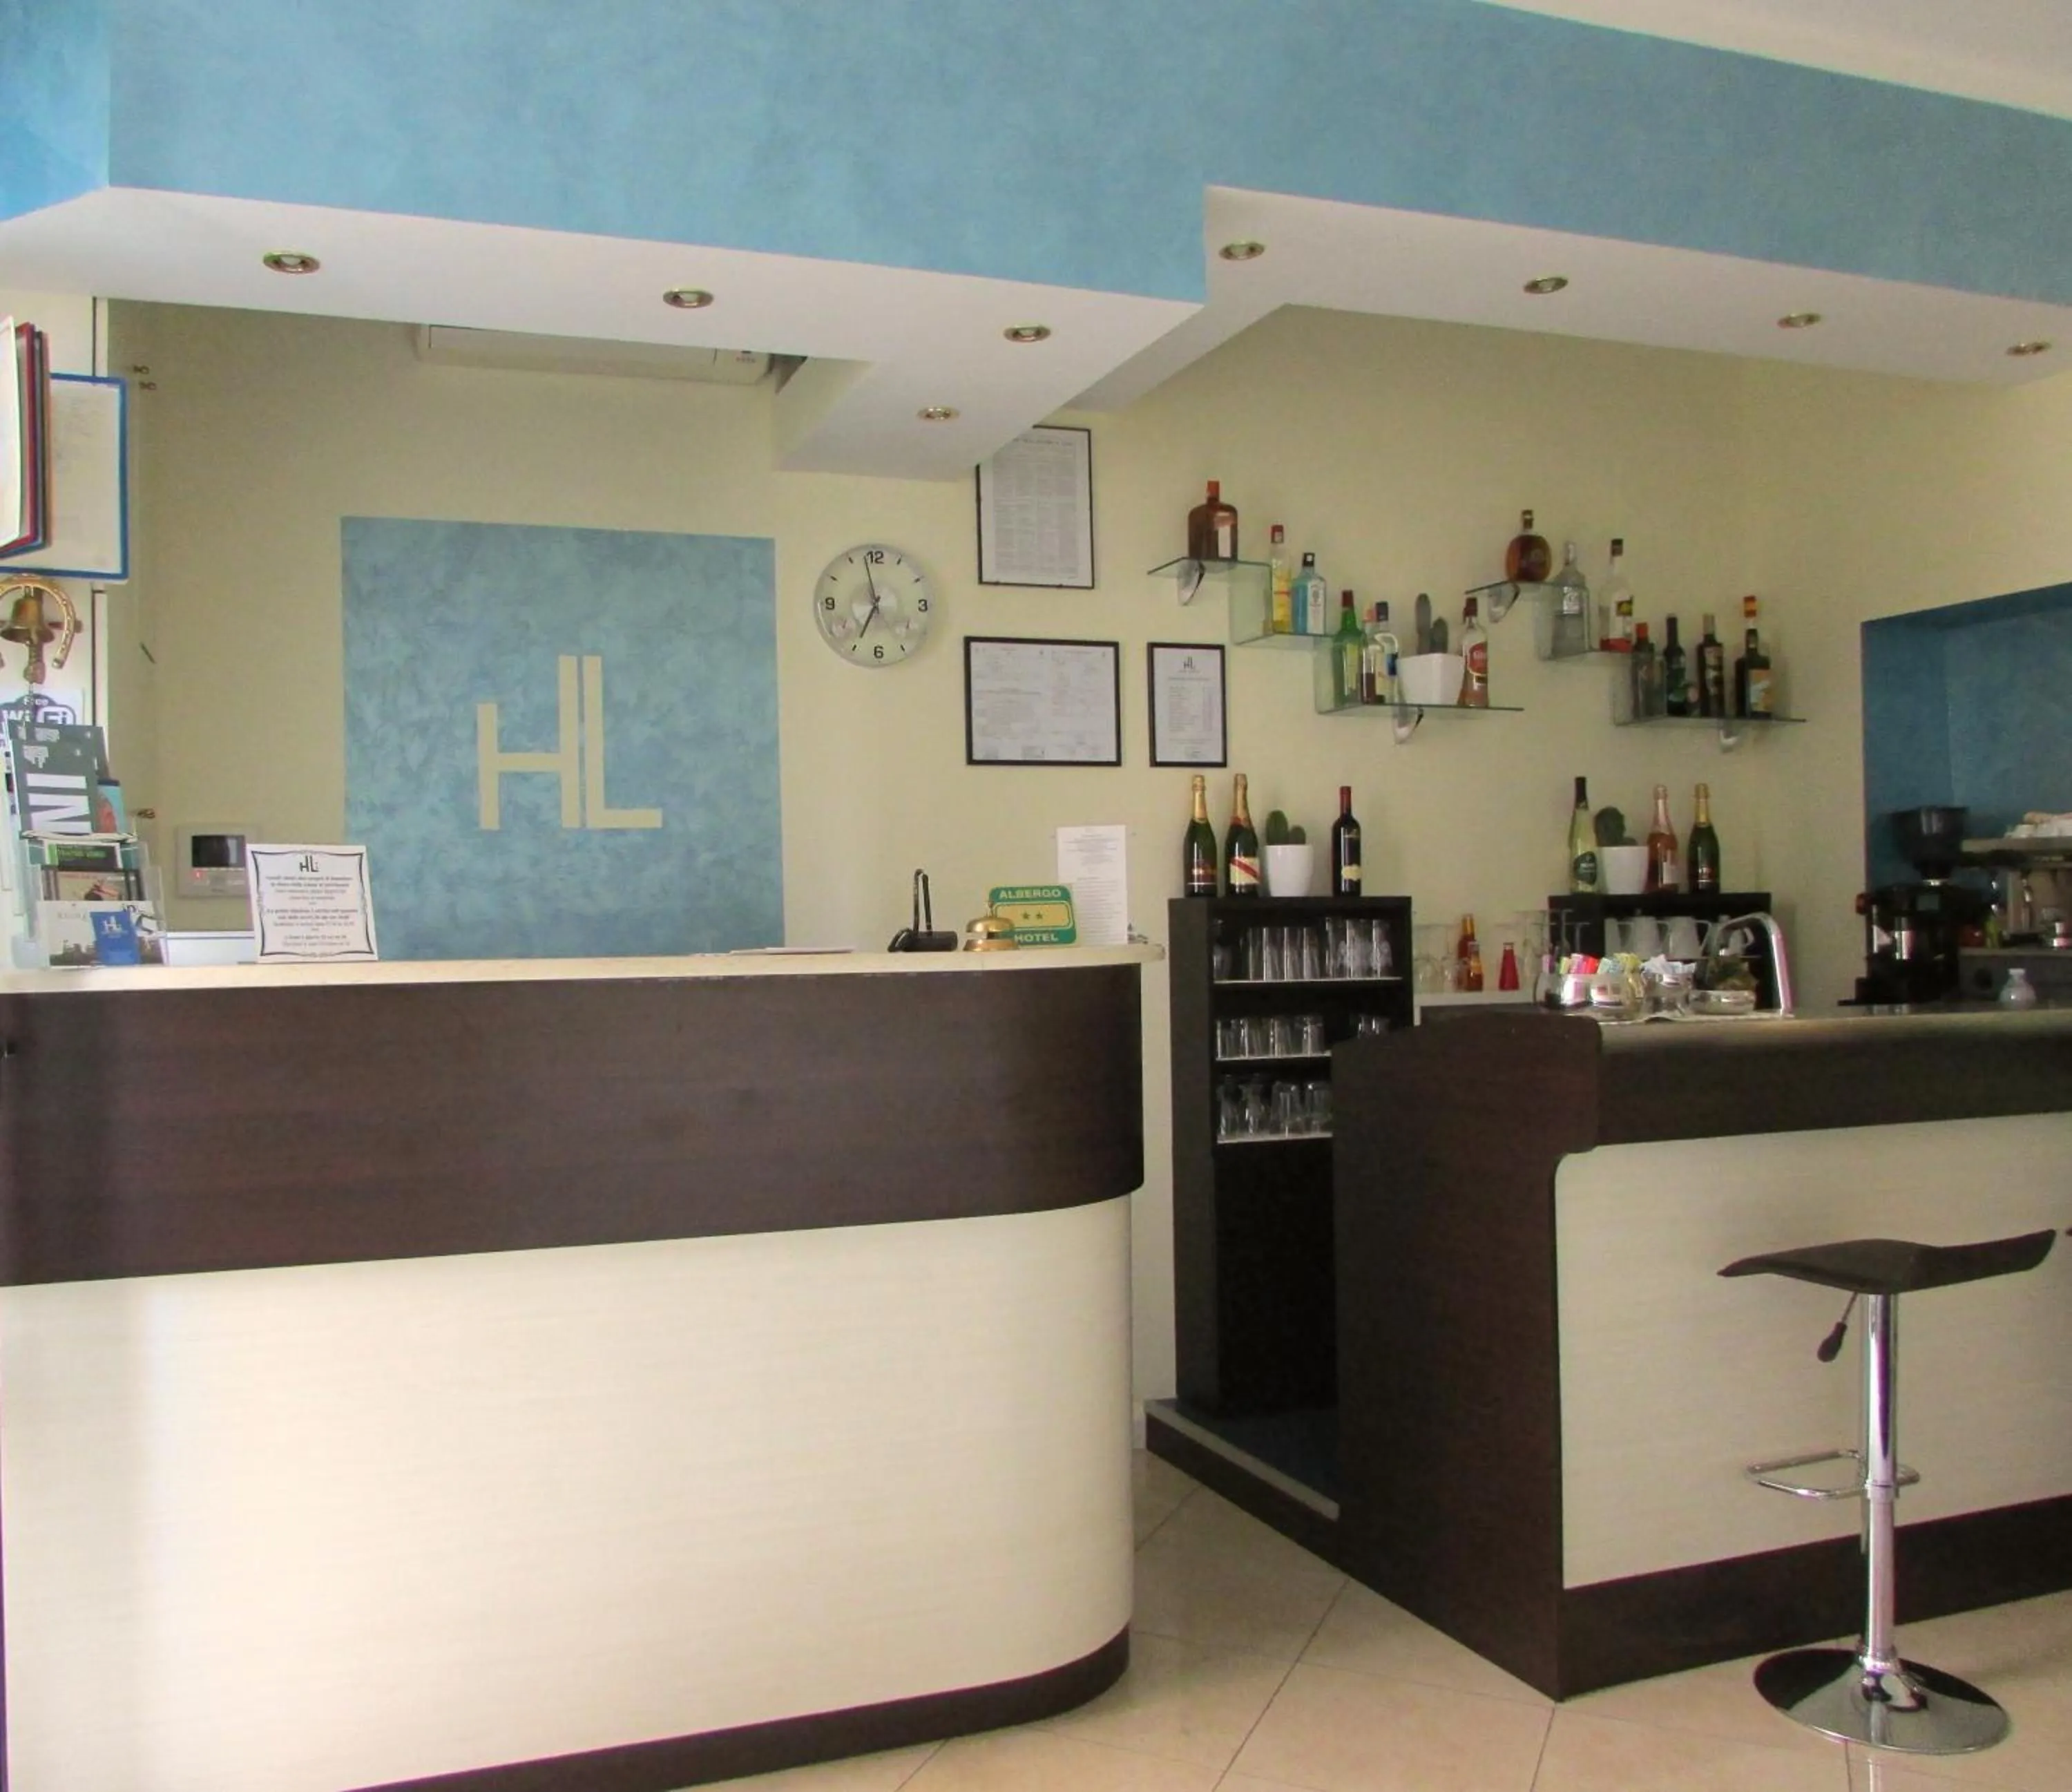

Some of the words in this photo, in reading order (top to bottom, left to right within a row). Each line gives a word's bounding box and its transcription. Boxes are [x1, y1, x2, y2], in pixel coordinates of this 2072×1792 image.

[867, 551, 884, 564] 12
[825, 597, 835, 610] 9
[918, 599, 928, 611] 3
[874, 646, 883, 658] 6
[477, 654, 663, 830] HL
[999, 888, 1062, 899] ALBERGO
[1014, 933, 1059, 943] HOTEL
